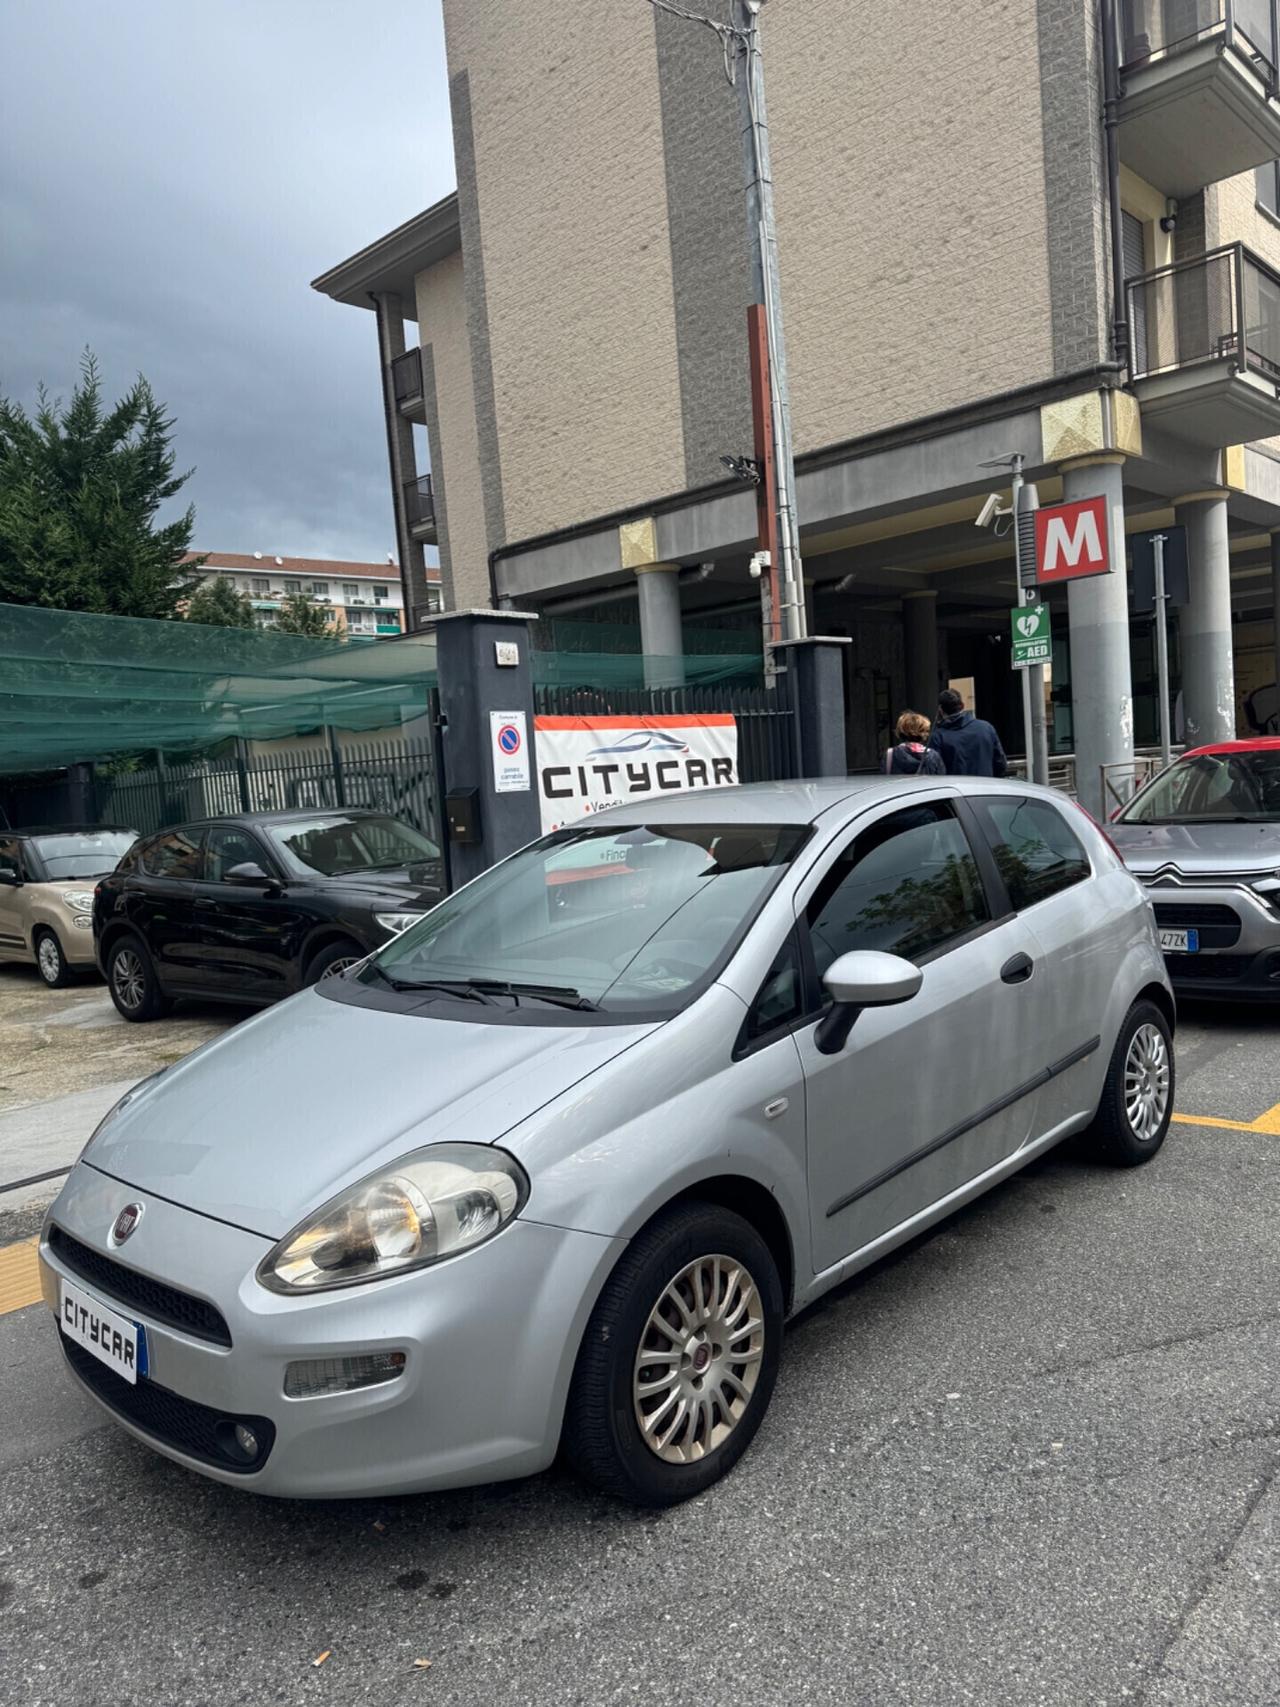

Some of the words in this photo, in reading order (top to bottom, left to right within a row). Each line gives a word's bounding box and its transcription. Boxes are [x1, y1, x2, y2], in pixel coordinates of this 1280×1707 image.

[1042, 510, 1104, 571] M
[1027, 645, 1048, 658] AED
[542, 757, 734, 799] CITYCAR
[1161, 933, 1187, 947] 47ZK
[64, 1296, 135, 1369] CITYCAR
